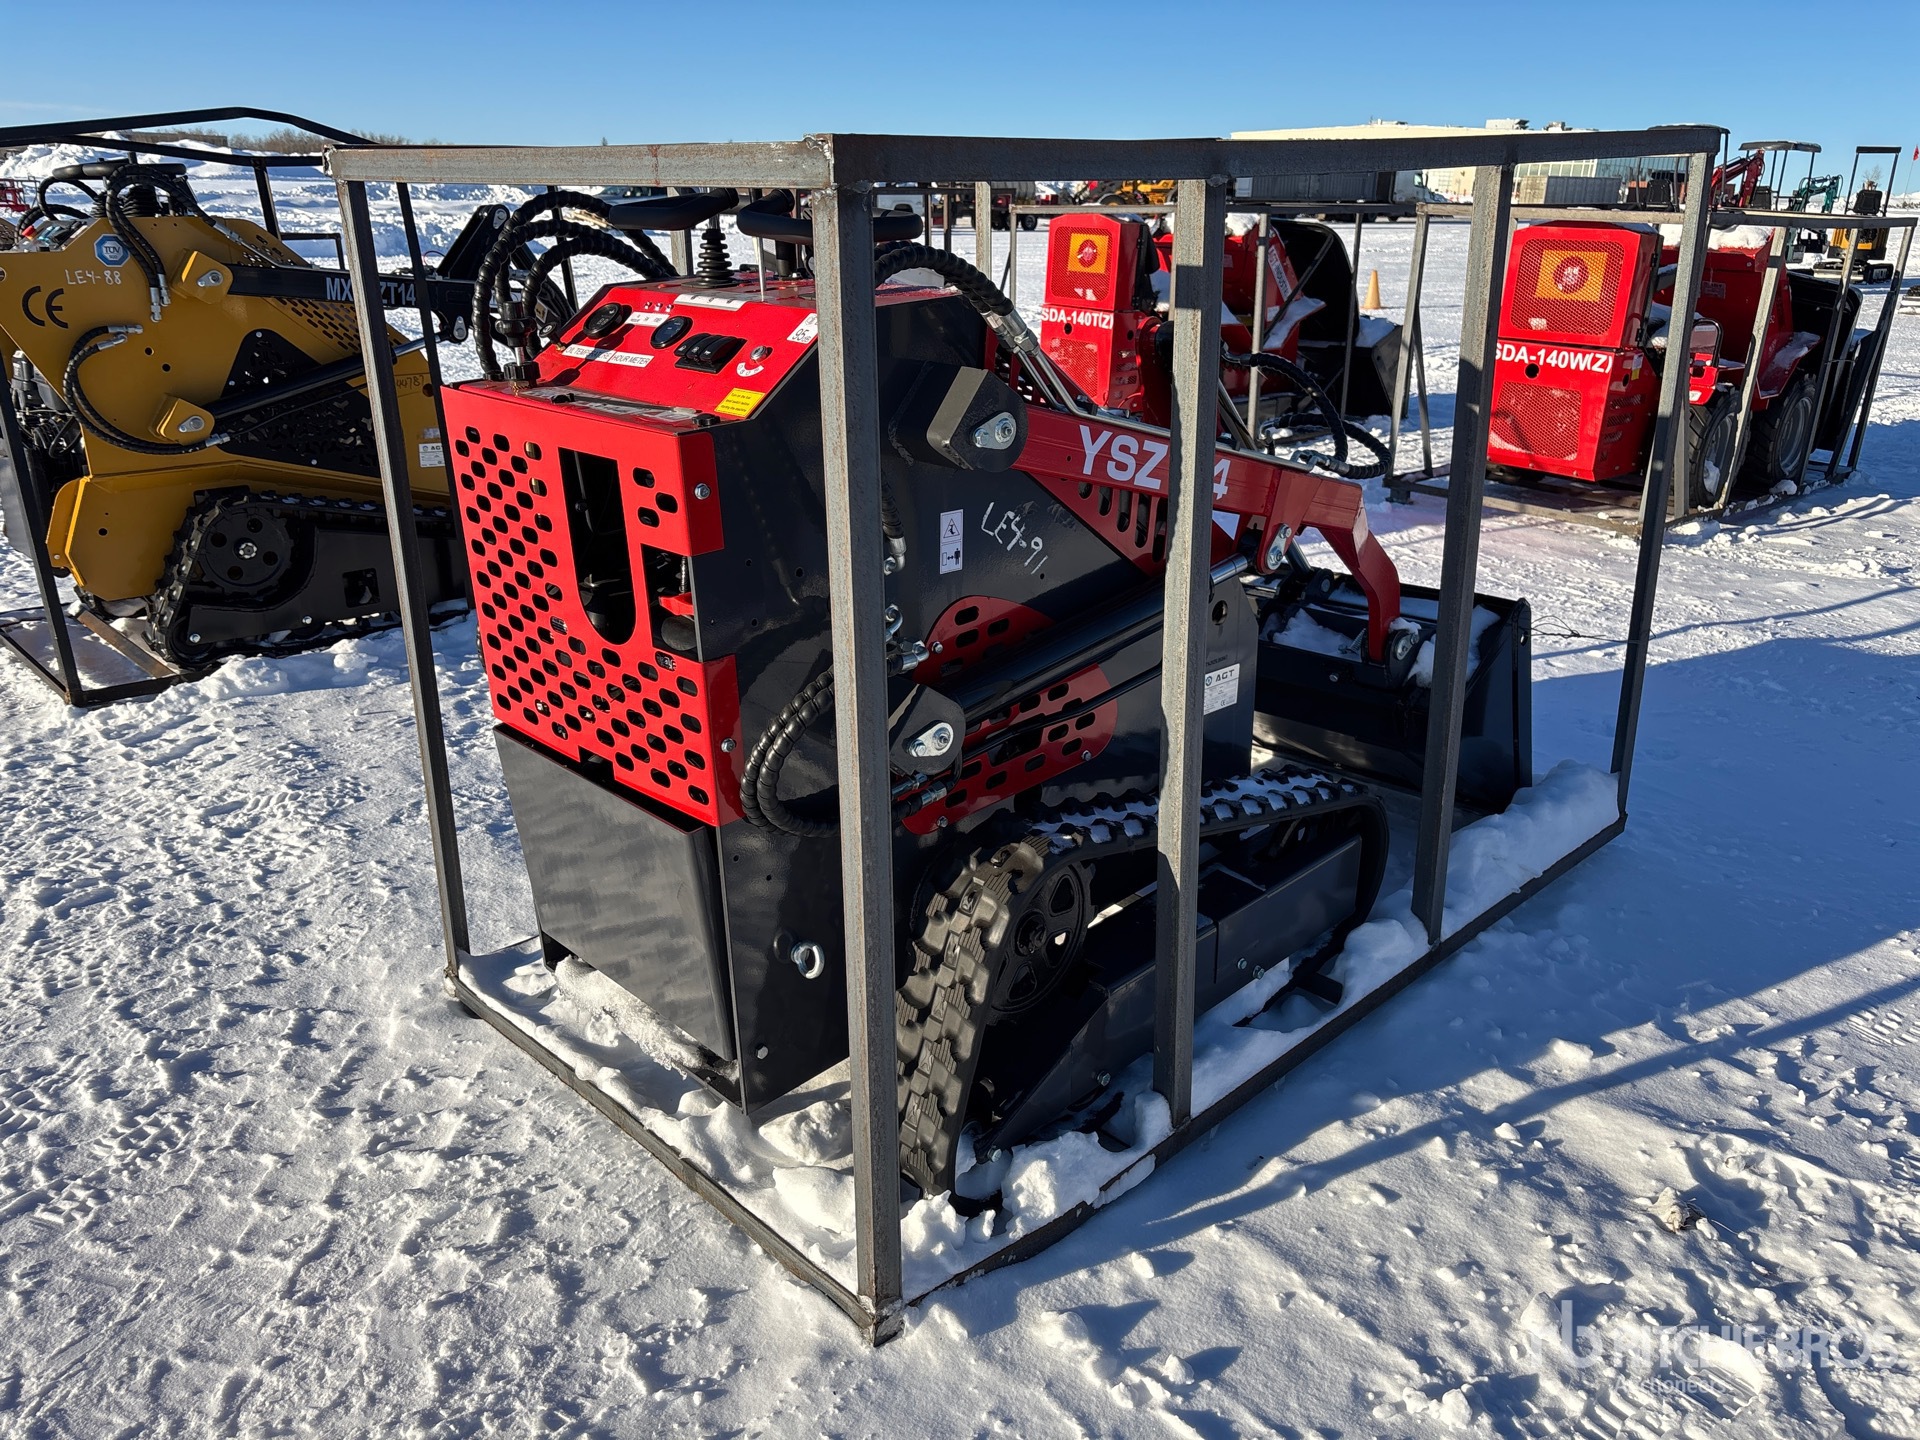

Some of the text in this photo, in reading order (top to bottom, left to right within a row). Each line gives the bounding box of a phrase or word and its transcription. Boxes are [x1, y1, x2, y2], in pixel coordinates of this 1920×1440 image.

[64, 268, 122, 285] LE4-88
[21, 285, 69, 329] CE
[1041, 307, 1115, 330] SDA-140T(Z)
[629, 355, 651, 365] METER
[1495, 342, 1614, 374] SDA-140W(Z)
[1079, 424, 1232, 500] YSZ4
[1215, 669, 1235, 682] AGT
